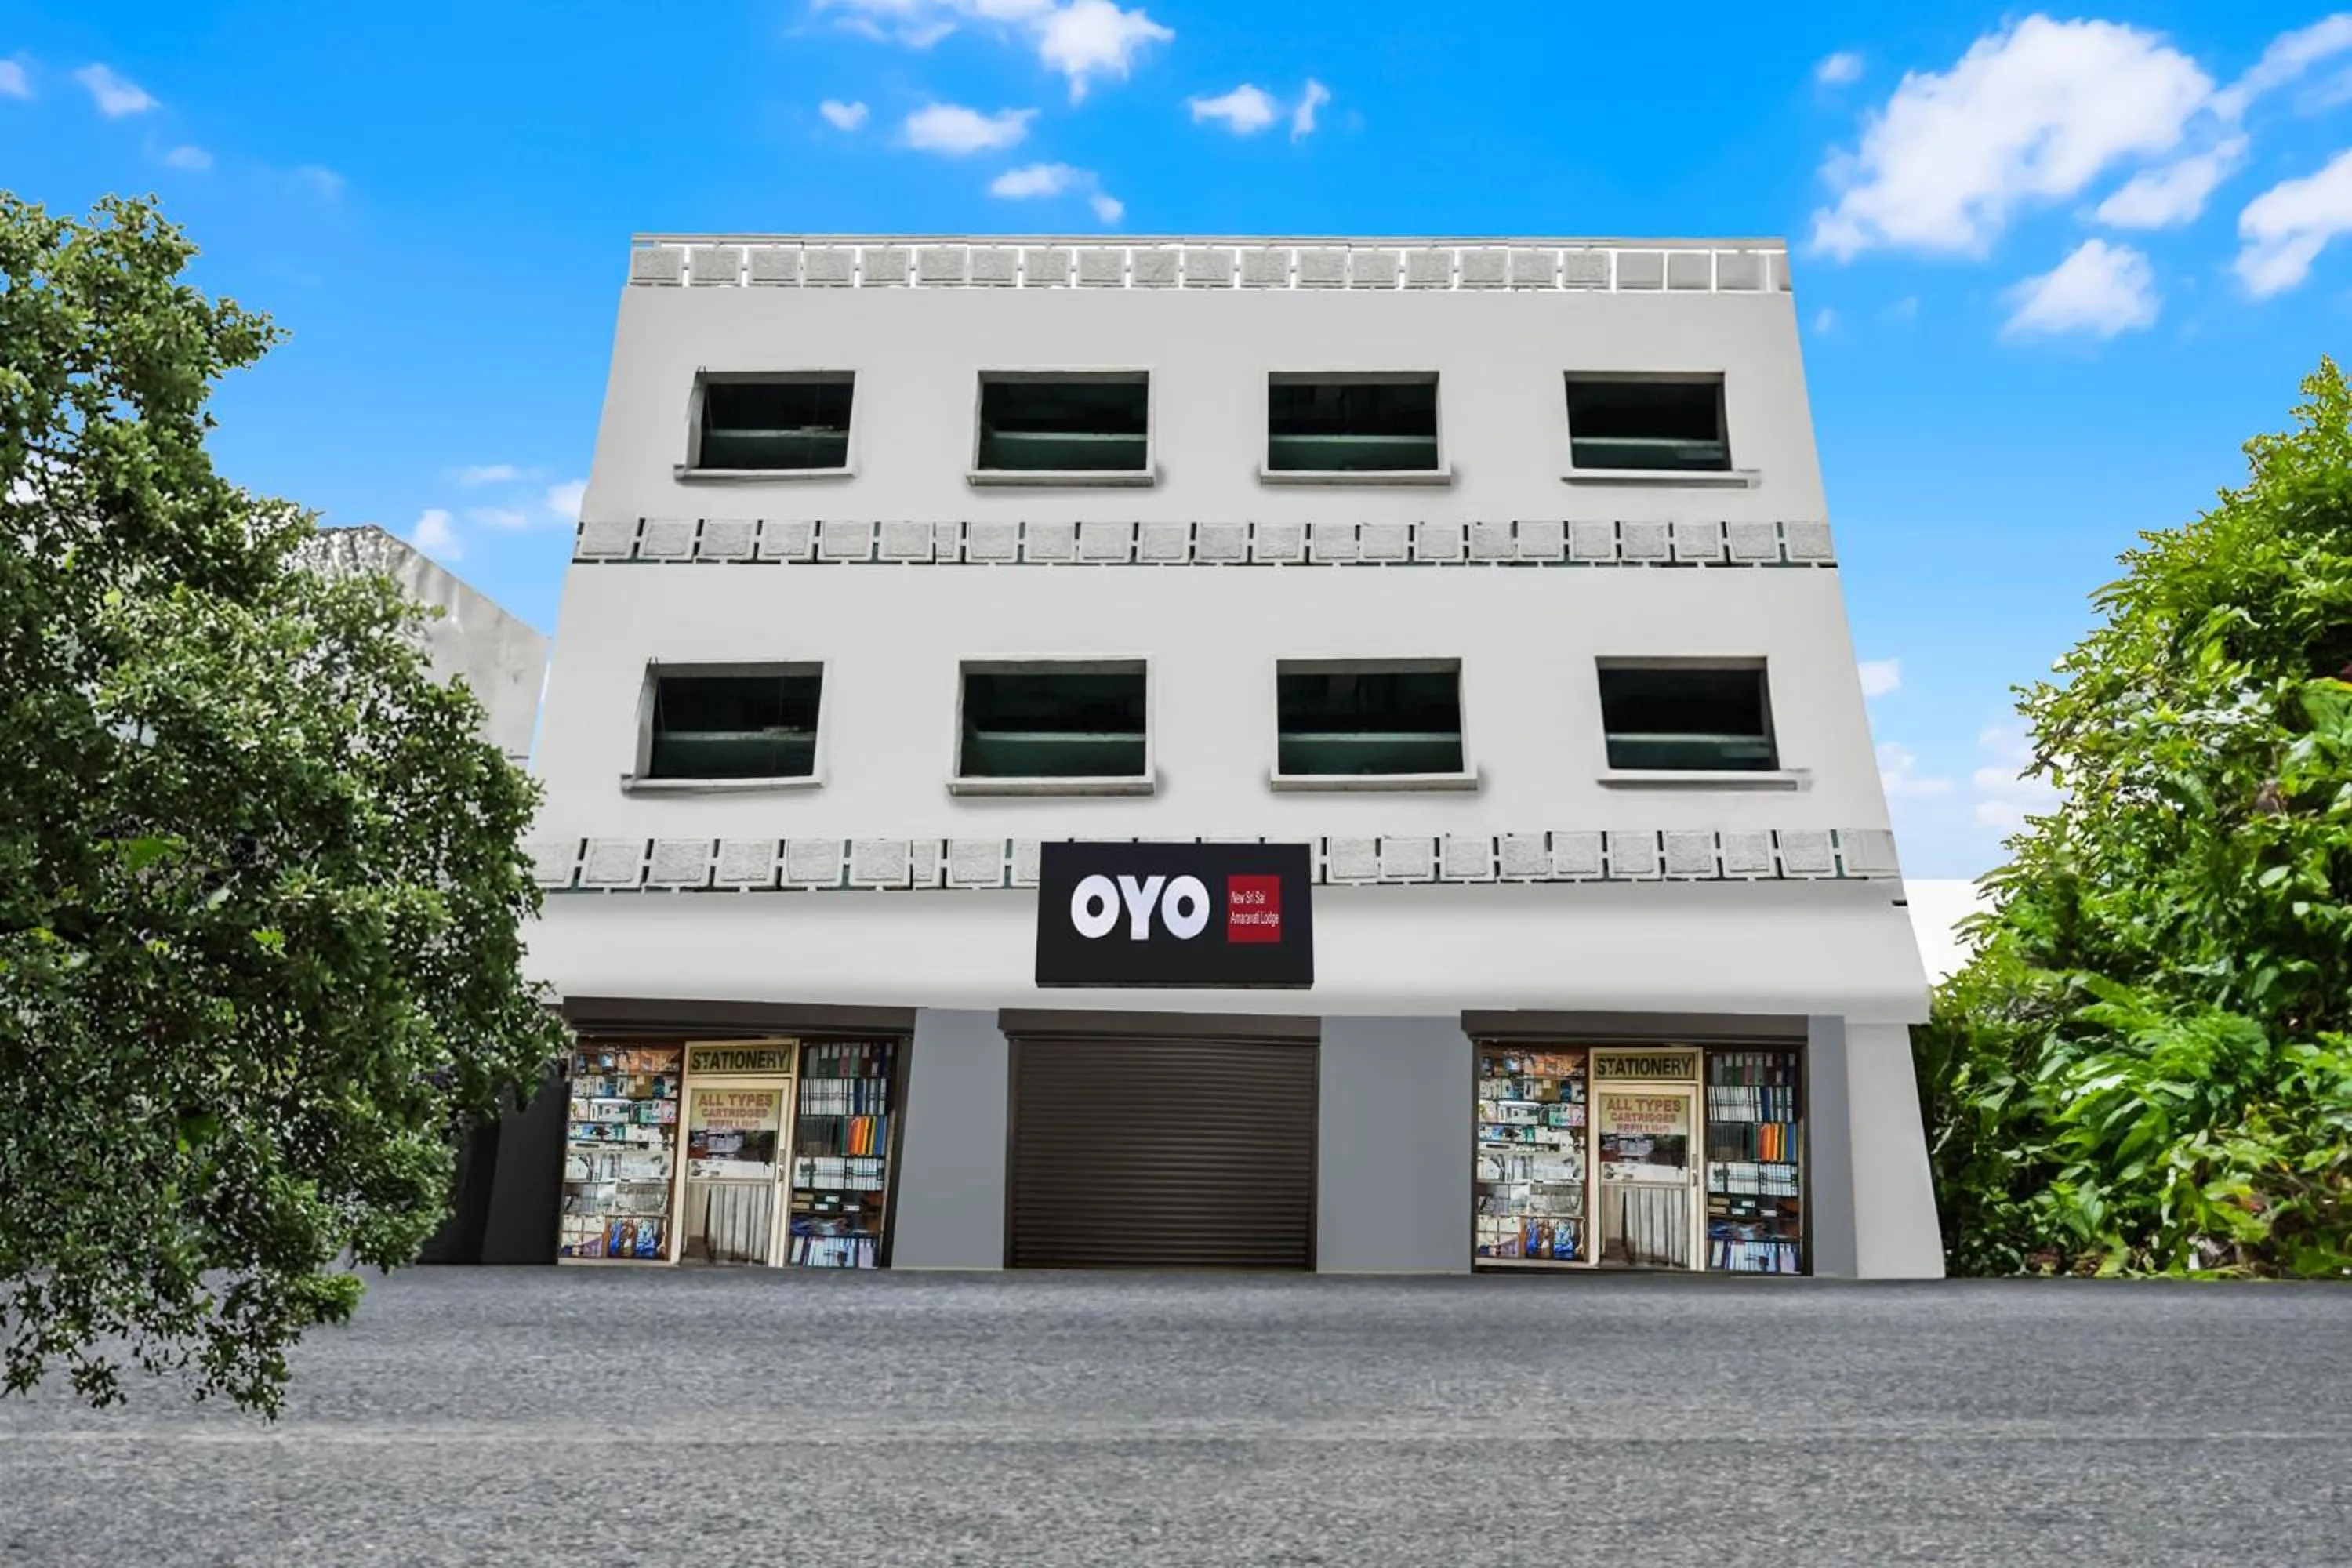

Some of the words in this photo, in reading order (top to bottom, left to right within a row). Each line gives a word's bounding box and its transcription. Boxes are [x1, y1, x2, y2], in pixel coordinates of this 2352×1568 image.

[1230, 891, 1244, 904] New
[1246, 890, 1254, 904] Sri
[1070, 874, 1210, 940] OYO
[1261, 911, 1280, 927] Lodge
[691, 1051, 788, 1070] STATIONERY
[1596, 1056, 1692, 1076] STATIONERY
[698, 1093, 724, 1107] ALL
[728, 1093, 774, 1108] TYPES
[1606, 1098, 1632, 1111] ALL
[1635, 1098, 1682, 1112] TYPES
